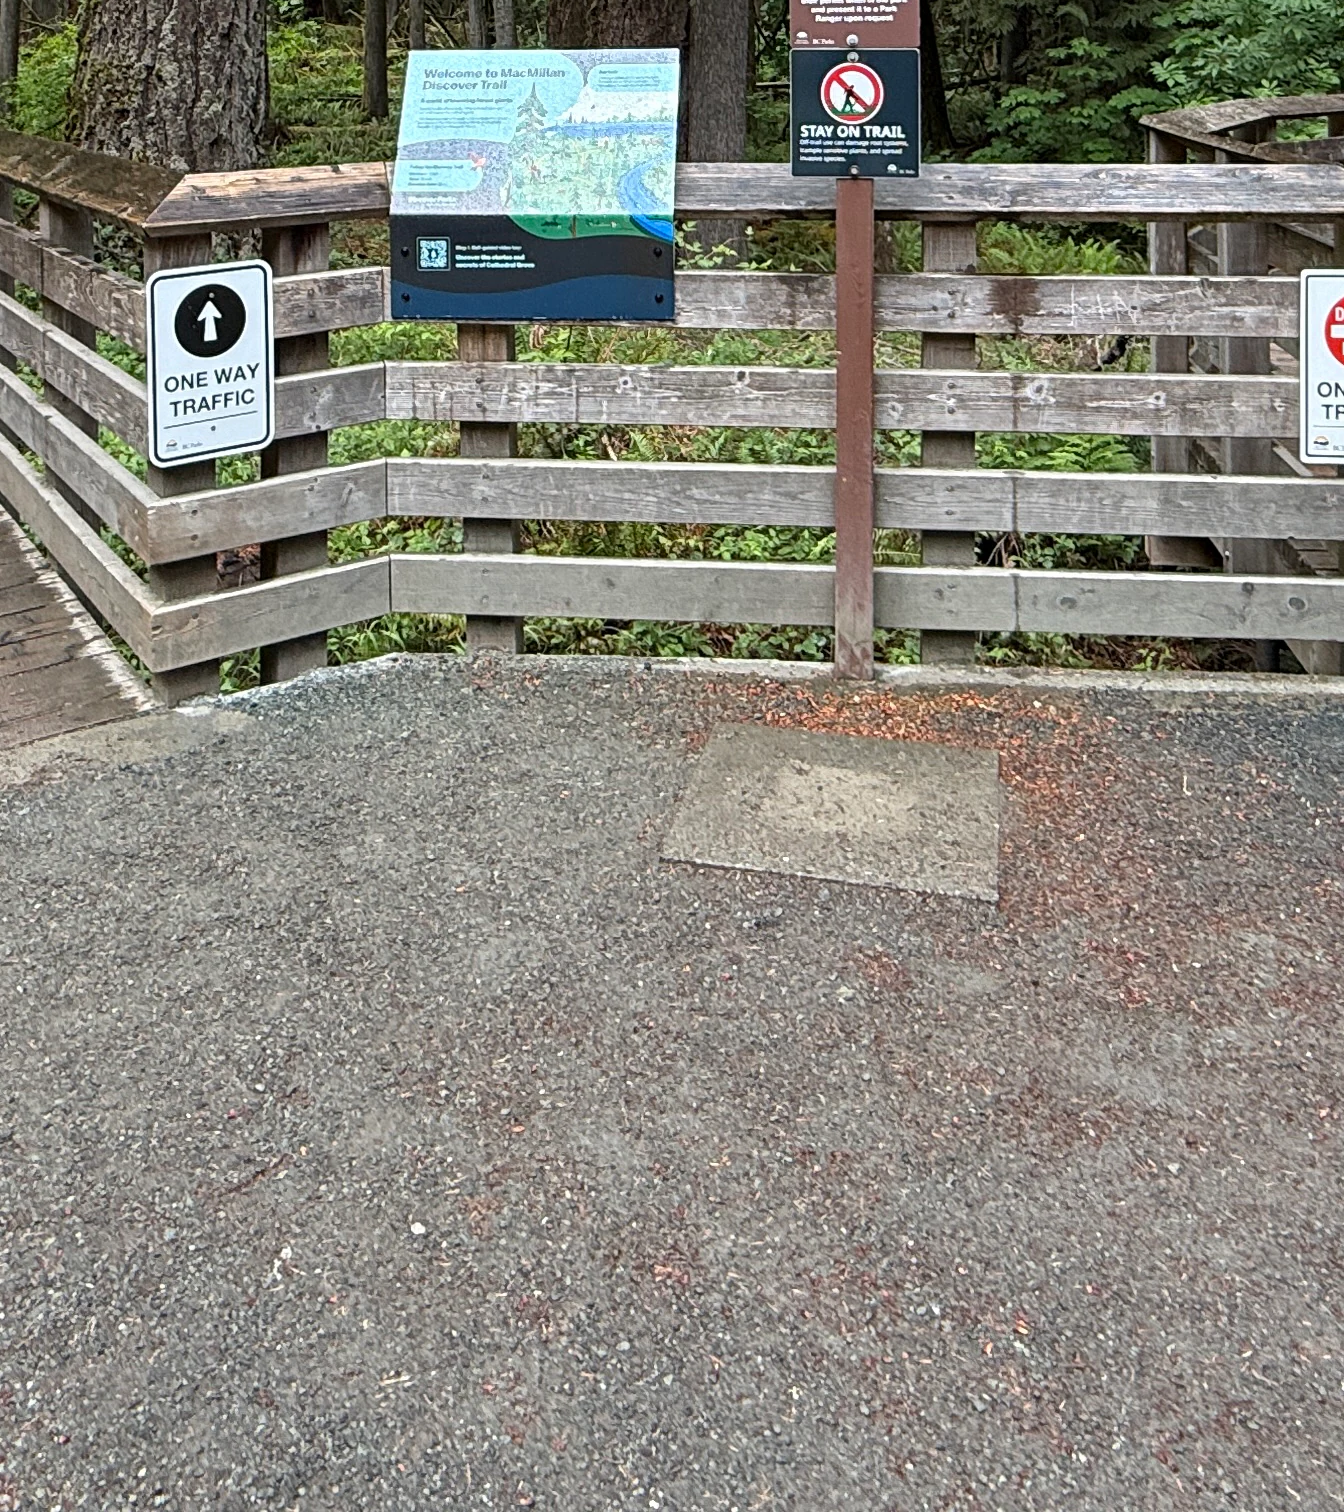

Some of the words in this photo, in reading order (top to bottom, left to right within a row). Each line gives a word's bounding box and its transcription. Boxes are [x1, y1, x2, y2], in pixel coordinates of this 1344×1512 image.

[826, 6, 855, 14] present
[815, 15, 843, 23] Ranger
[424, 68, 482, 78] Welcome
[485, 69, 498, 78] to
[500, 68, 566, 78] MacMillan
[422, 81, 478, 90] Discover
[480, 80, 508, 90] Trail
[799, 124, 834, 137] STAY
[837, 125, 860, 138] ON
[863, 125, 905, 138] TRAIL
[164, 371, 208, 393] ONE
[214, 362, 260, 385] WAY
[169, 388, 255, 417] TRAFFIC
